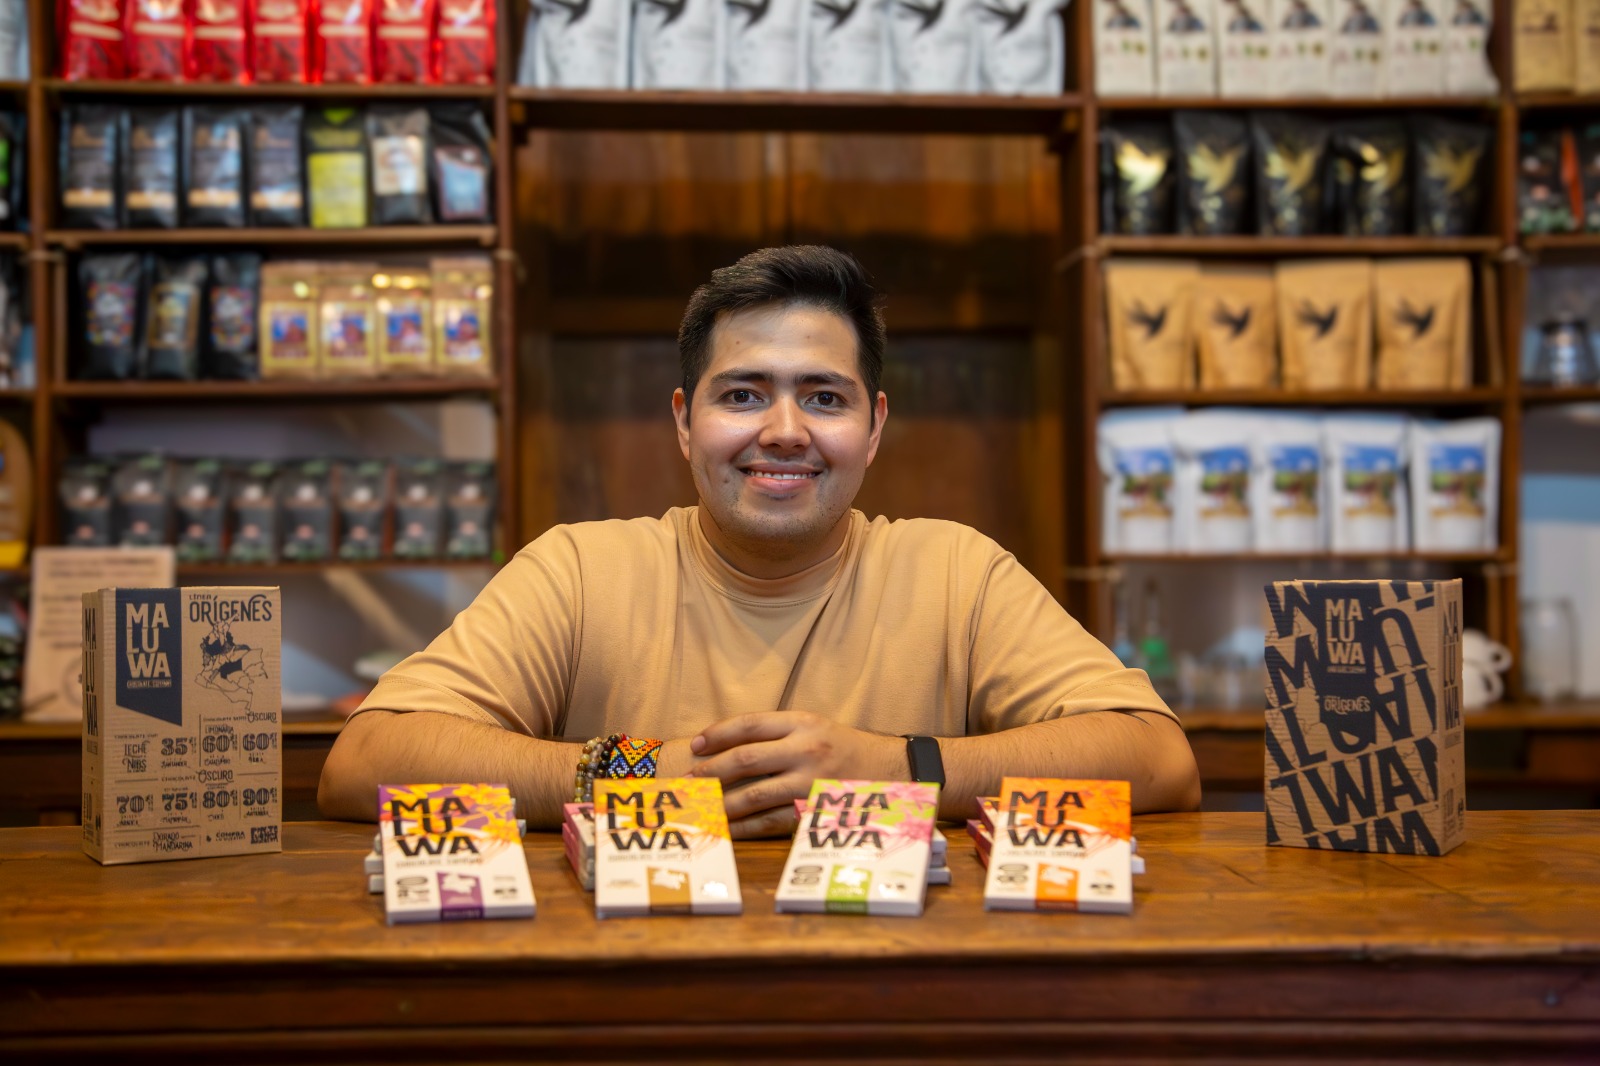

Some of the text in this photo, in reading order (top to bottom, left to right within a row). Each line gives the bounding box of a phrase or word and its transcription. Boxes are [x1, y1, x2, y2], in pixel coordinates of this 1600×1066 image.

[126, 603, 170, 628] MA
[1325, 599, 1363, 621] MA
[127, 629, 160, 653] LU
[1326, 621, 1355, 642] LU
[1327, 642, 1366, 665] WA
[126, 653, 171, 679] WA
[196, 770, 234, 783] OSCURO
[391, 797, 470, 815] MA
[607, 791, 683, 810] MA
[815, 793, 890, 810] MA
[1010, 791, 1085, 808] MA
[393, 815, 453, 836] LU
[608, 811, 666, 830] LU
[809, 811, 871, 829] LU
[1007, 809, 1066, 827] LU
[396, 835, 481, 857] WA
[610, 831, 690, 850] WA
[808, 831, 883, 849] WA
[1007, 829, 1086, 848] WA
